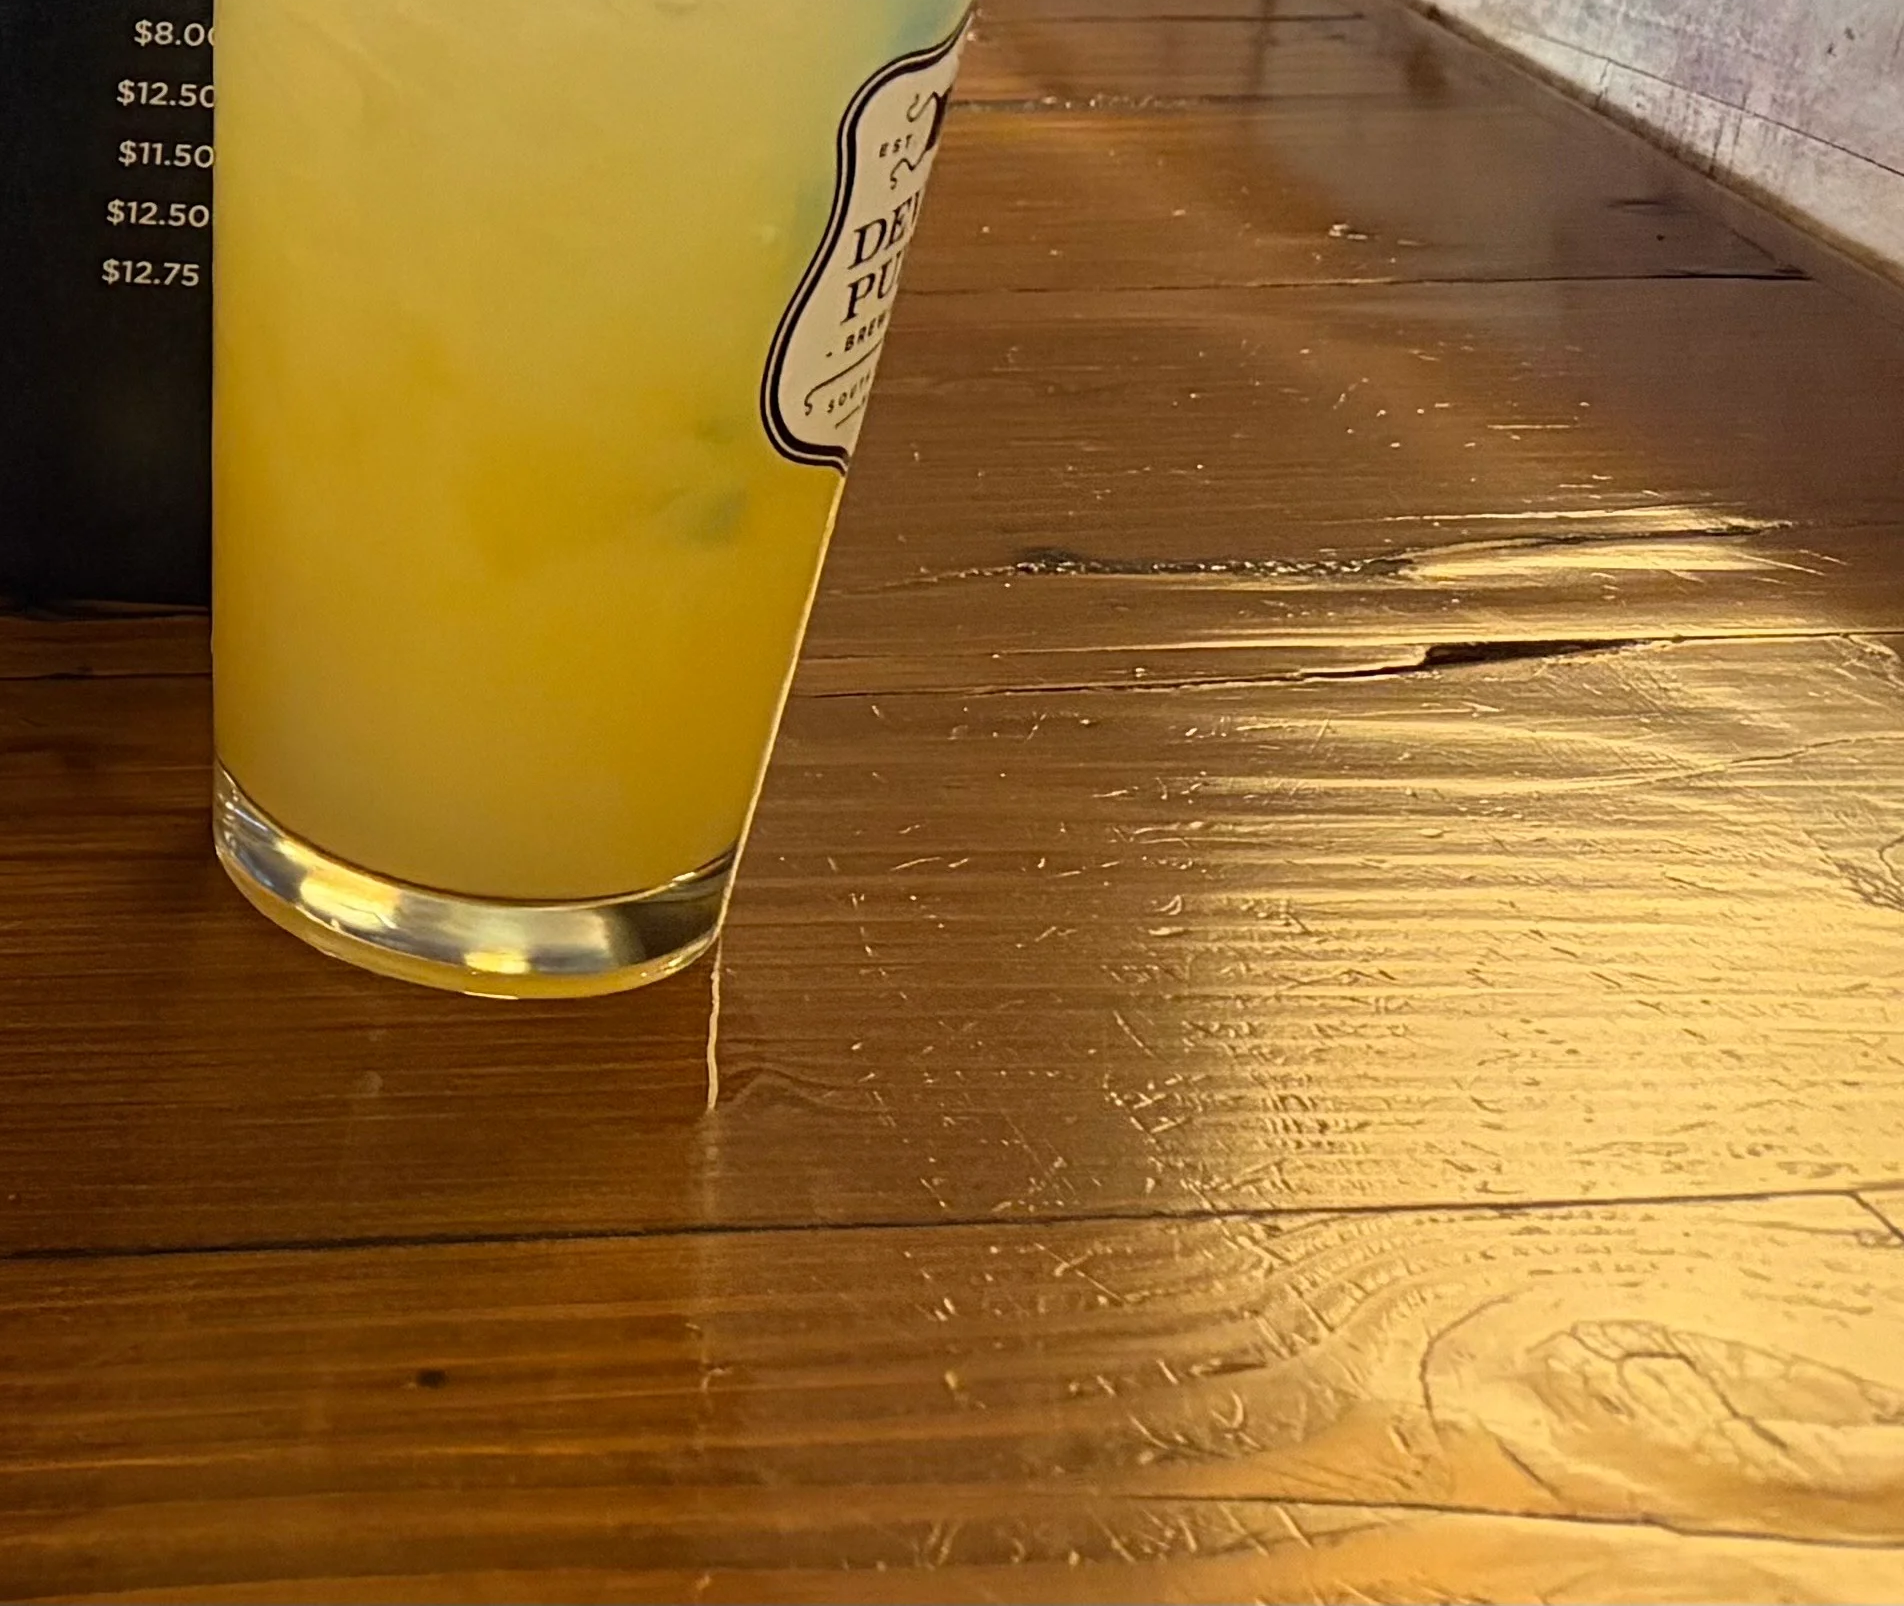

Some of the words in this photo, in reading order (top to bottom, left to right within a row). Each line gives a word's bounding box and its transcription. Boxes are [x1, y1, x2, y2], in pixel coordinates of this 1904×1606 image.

[118, 139, 213, 169] $11.50
[106, 198, 210, 228] $12.50
[101, 258, 200, 287] $12.75
